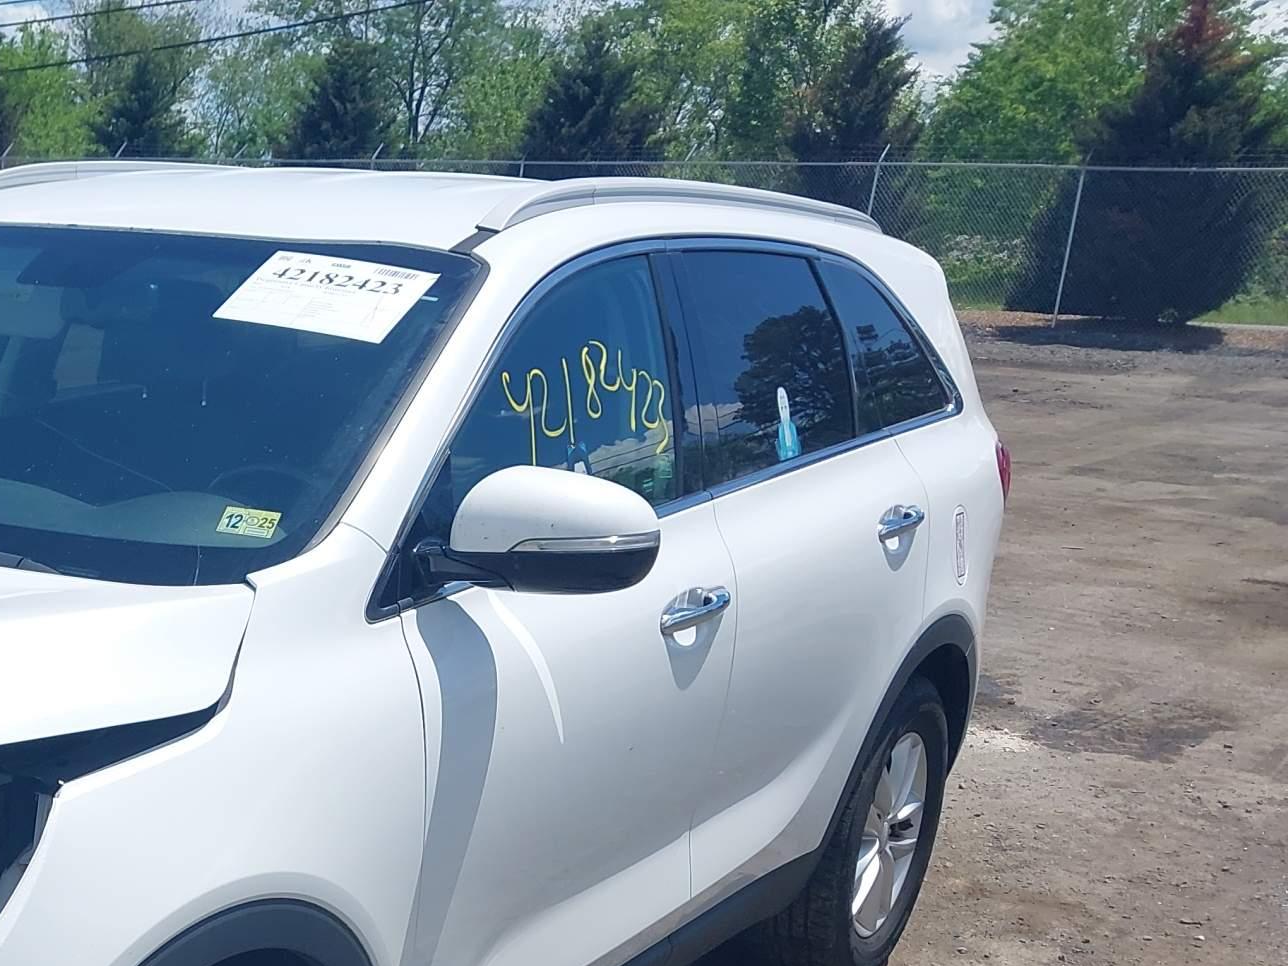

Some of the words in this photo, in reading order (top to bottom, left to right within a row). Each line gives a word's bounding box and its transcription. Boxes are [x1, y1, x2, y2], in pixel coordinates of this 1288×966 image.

[271, 266, 404, 296] 42182423
[501, 338, 669, 466] 42182423
[225, 513, 244, 529] 12
[258, 517, 277, 530] 25
